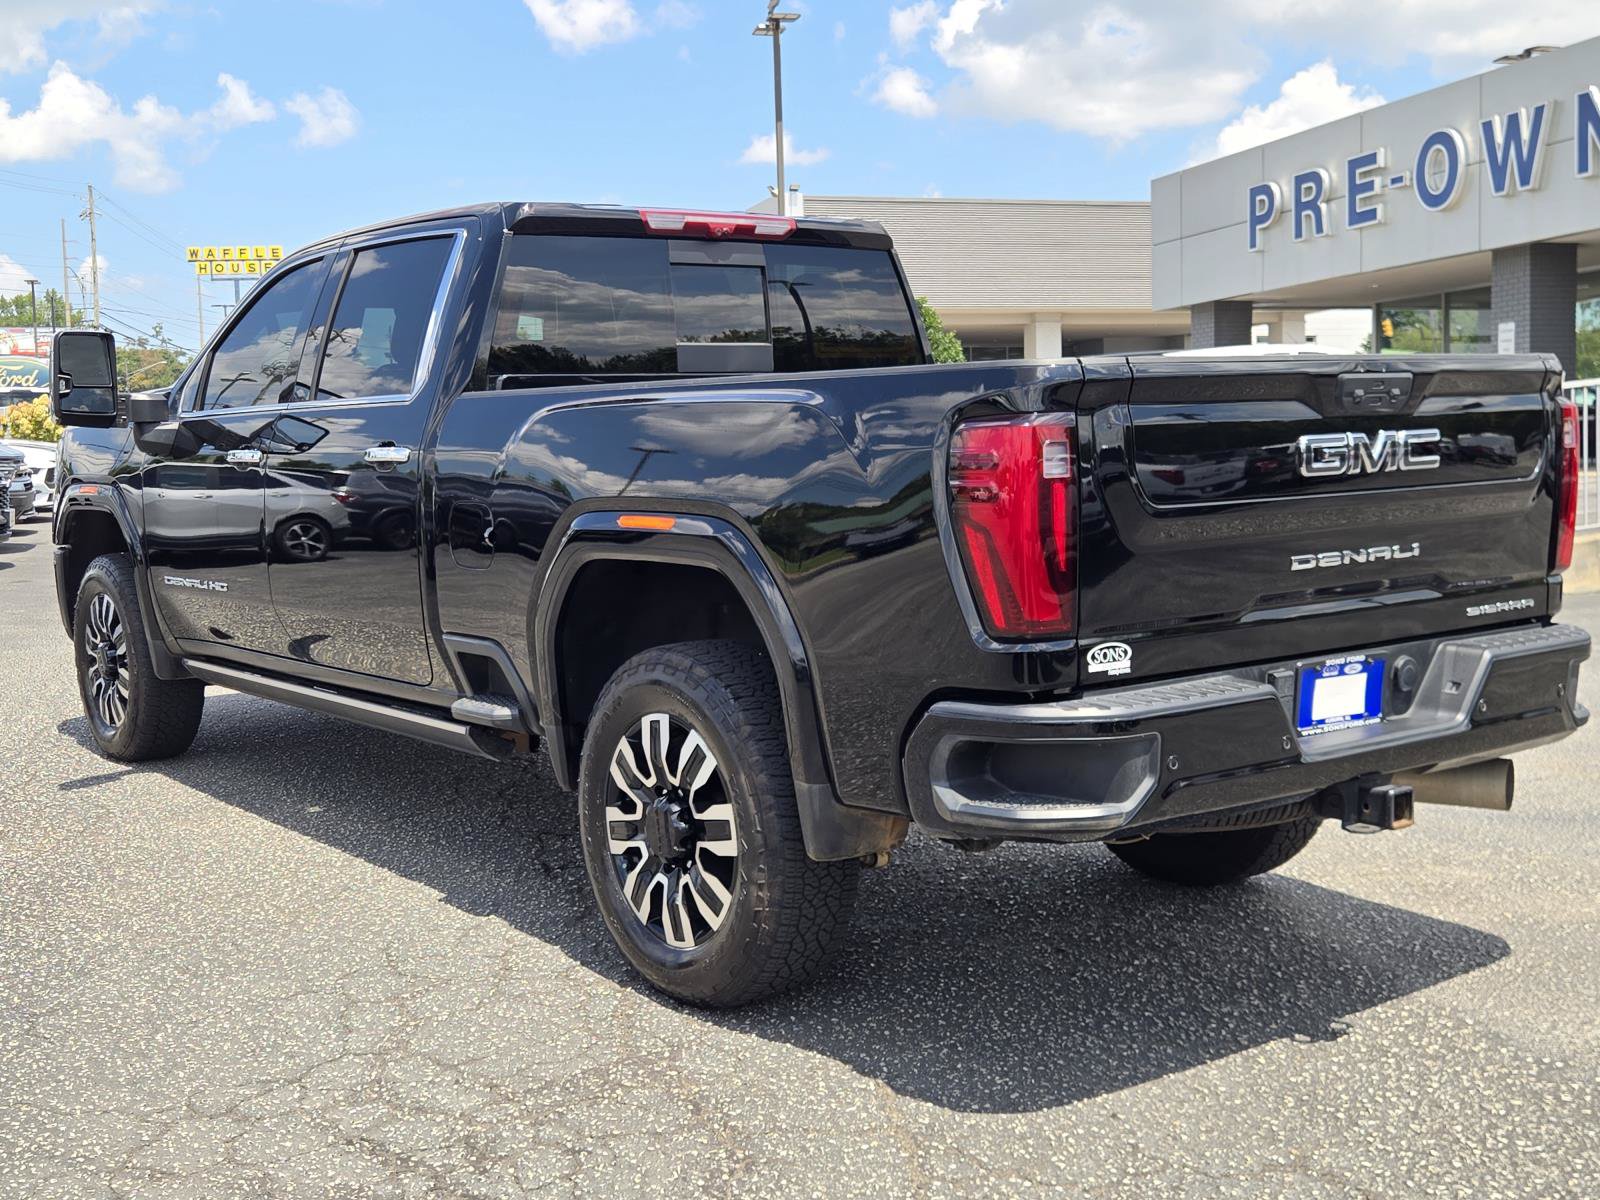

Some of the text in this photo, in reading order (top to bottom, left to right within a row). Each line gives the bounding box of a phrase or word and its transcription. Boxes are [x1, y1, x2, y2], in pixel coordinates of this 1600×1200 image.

[189, 248, 280, 258] WAFFLE
[1300, 427, 1441, 478] GMC
[1290, 542, 1421, 572] DENALI
[163, 575, 208, 590] DENALI
[1465, 598, 1536, 617] SIERRA
[1093, 647, 1126, 665] SONS
